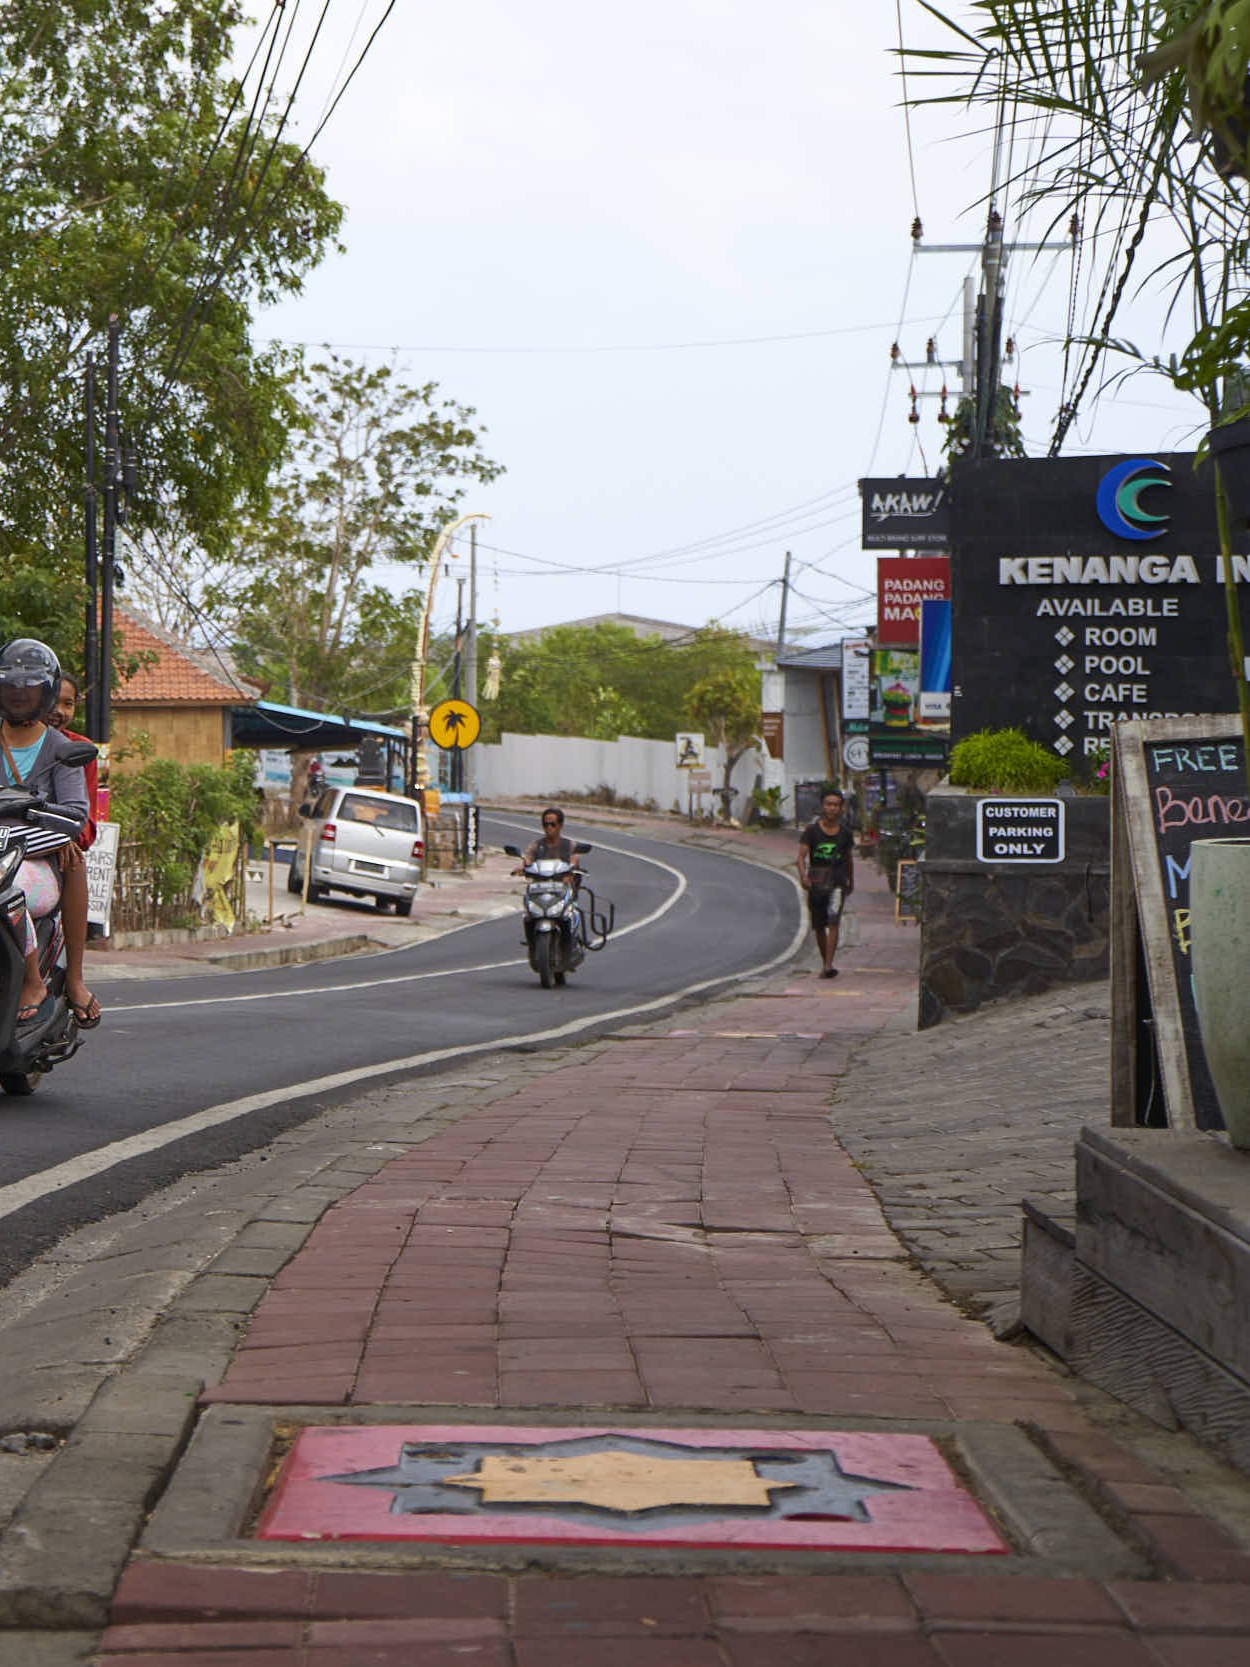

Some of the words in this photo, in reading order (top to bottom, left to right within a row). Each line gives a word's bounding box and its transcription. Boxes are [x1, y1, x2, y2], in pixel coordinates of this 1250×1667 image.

[999, 554, 1201, 585] KENANGA
[883, 579, 945, 592] PADANG
[1036, 598, 1180, 617] AVAILABLE
[1084, 627, 1157, 646] ROOM
[1084, 656, 1151, 675] POOL
[1084, 684, 1148, 703] CAFE
[1152, 745, 1239, 773] FREE
[985, 806, 1057, 818] CUSTOMER
[988, 826, 1054, 837] PARKING
[993, 843, 1046, 855] ONLY
